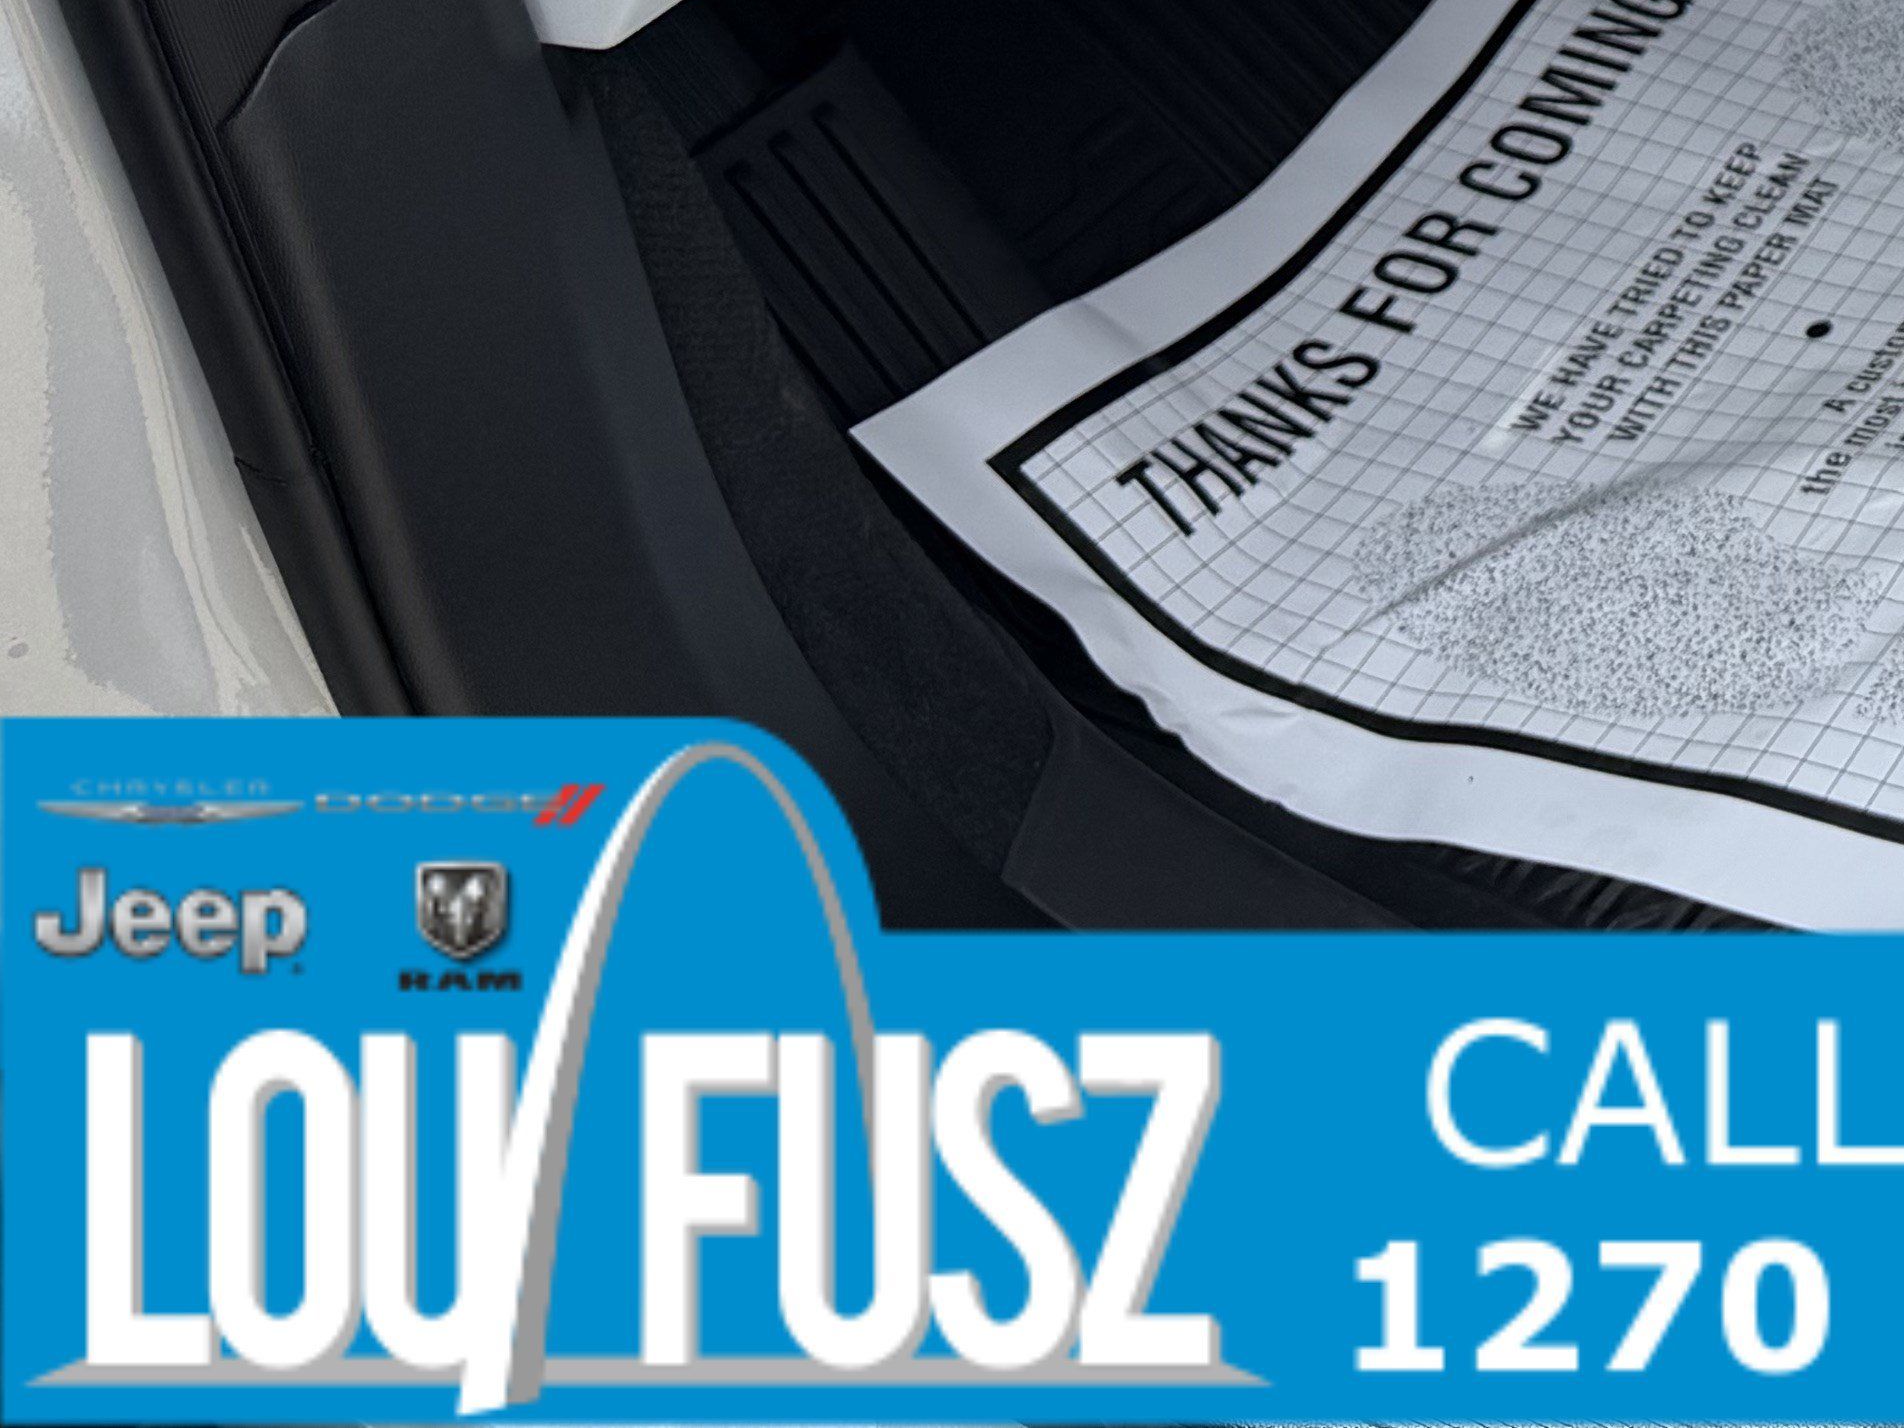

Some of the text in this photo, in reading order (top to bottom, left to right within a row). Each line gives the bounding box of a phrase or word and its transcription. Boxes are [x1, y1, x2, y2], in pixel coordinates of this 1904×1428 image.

[1116, 339, 1381, 536] THANKS
[1339, 211, 1498, 333] FOR
[1511, 142, 1763, 433] WE HAVE TRIED TO KEEP
[1551, 151, 1810, 445] YOUR CARPETING CLEAN
[1607, 175, 1839, 443] WITH THIS PAPER MAT
[1822, 397, 1855, 414] A
[1800, 450, 1853, 496] the
